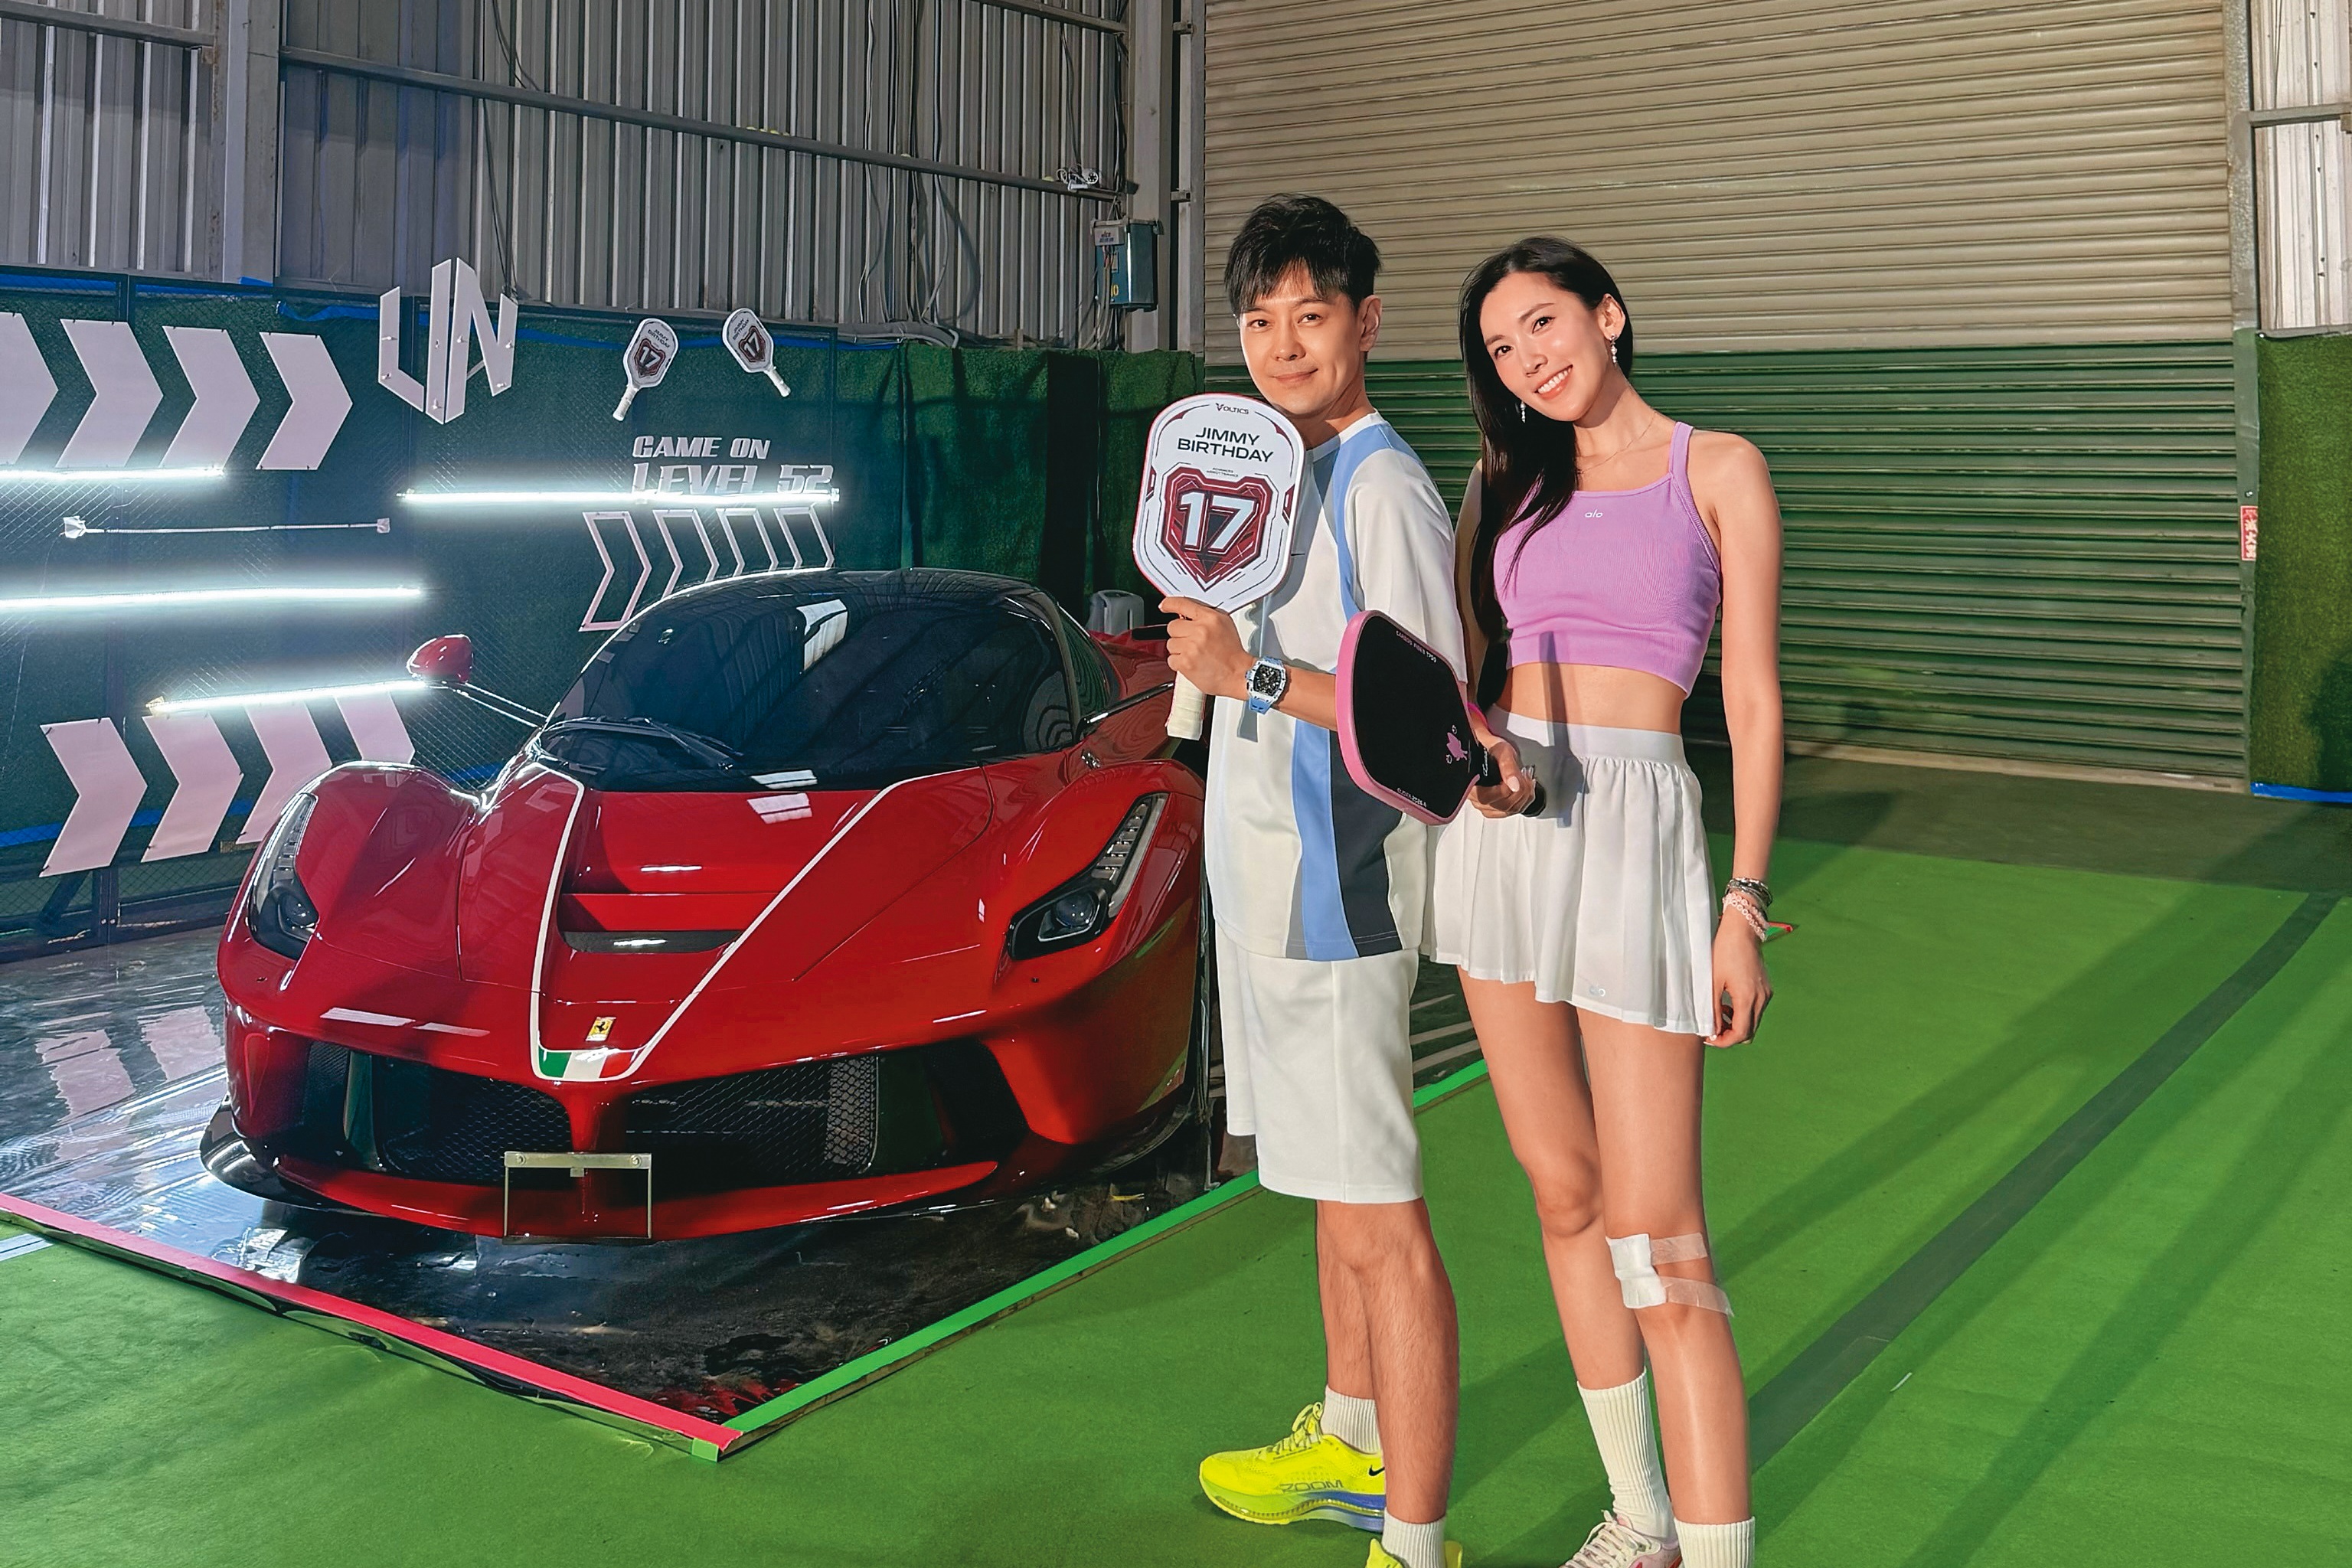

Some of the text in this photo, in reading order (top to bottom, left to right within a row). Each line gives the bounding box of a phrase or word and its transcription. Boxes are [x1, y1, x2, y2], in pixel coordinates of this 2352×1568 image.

[743, 332, 760, 358] 17
[639, 346, 662, 368] 17
[632, 436, 771, 459] GAME ON
[1195, 426, 1260, 446] JIMMY
[1178, 438, 1274, 462] BIRTHDAY
[632, 462, 834, 495] LEVEL 52
[1178, 491, 1256, 554] 17
[1279, 1479, 1344, 1493] ZOOM
